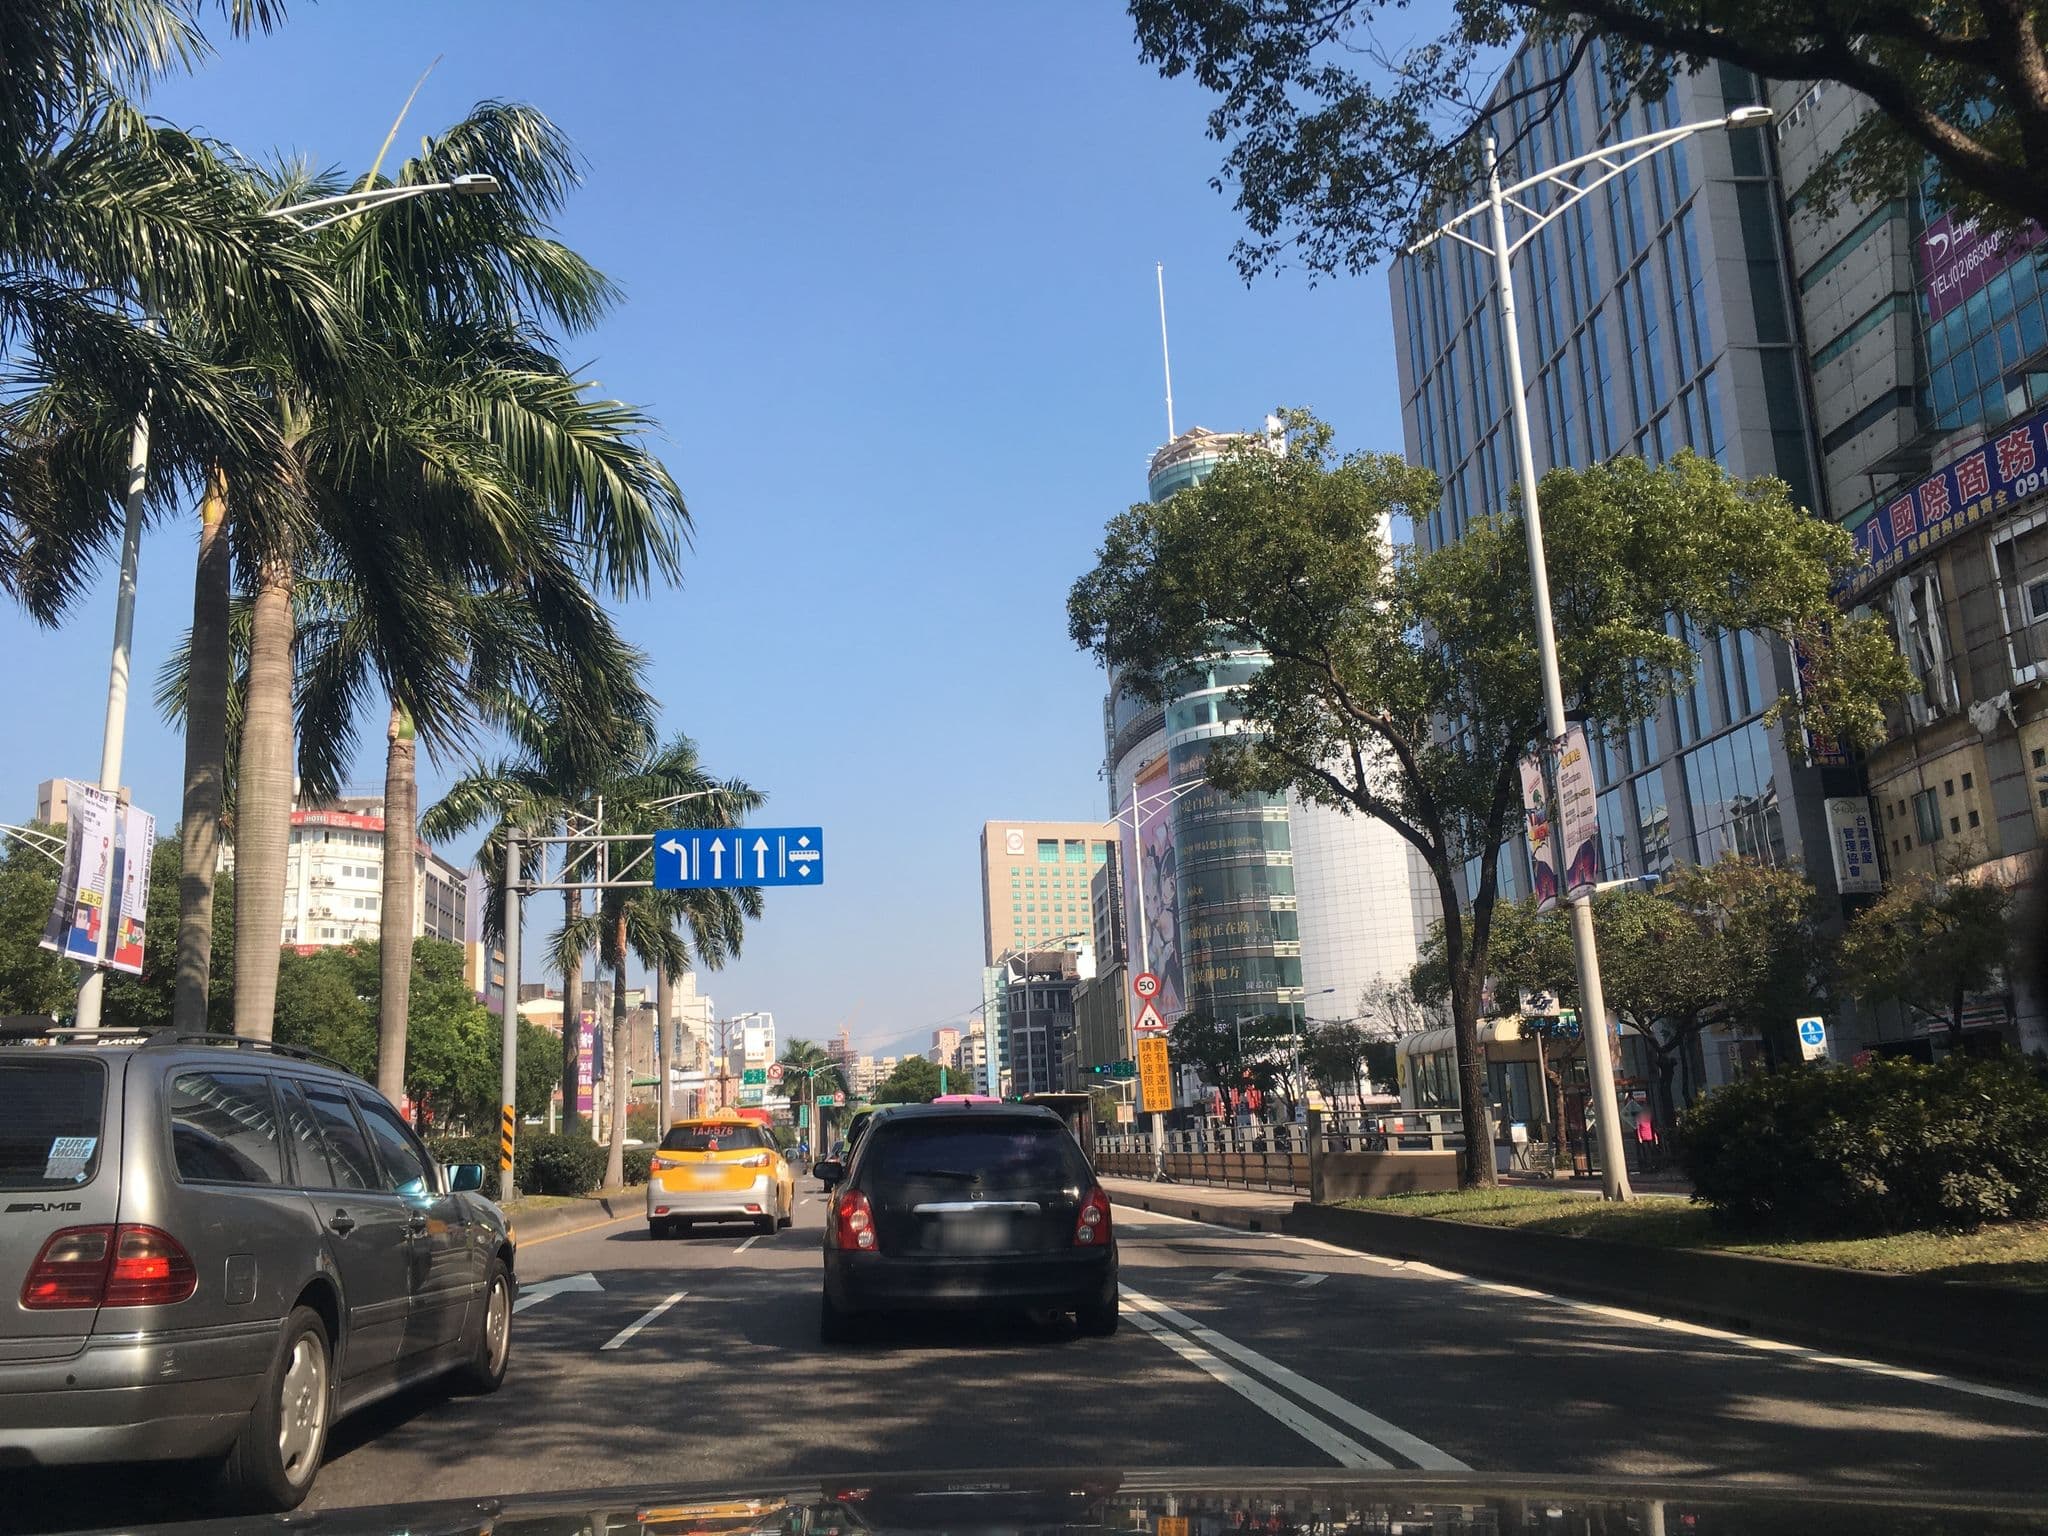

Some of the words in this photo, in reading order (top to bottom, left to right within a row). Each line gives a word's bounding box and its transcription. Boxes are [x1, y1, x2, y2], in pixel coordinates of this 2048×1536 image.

[1850, 422, 2048, 560] 八國際商務
[1139, 981, 1155, 991] 50
[1142, 1041, 1156, 1109] 請依速限行駛
[1154, 1041, 1168, 1109] 前有測速照相
[56, 1139, 91, 1148] SURF
[52, 1149, 89, 1158] MORE
[29, 1202, 82, 1212] AMG
